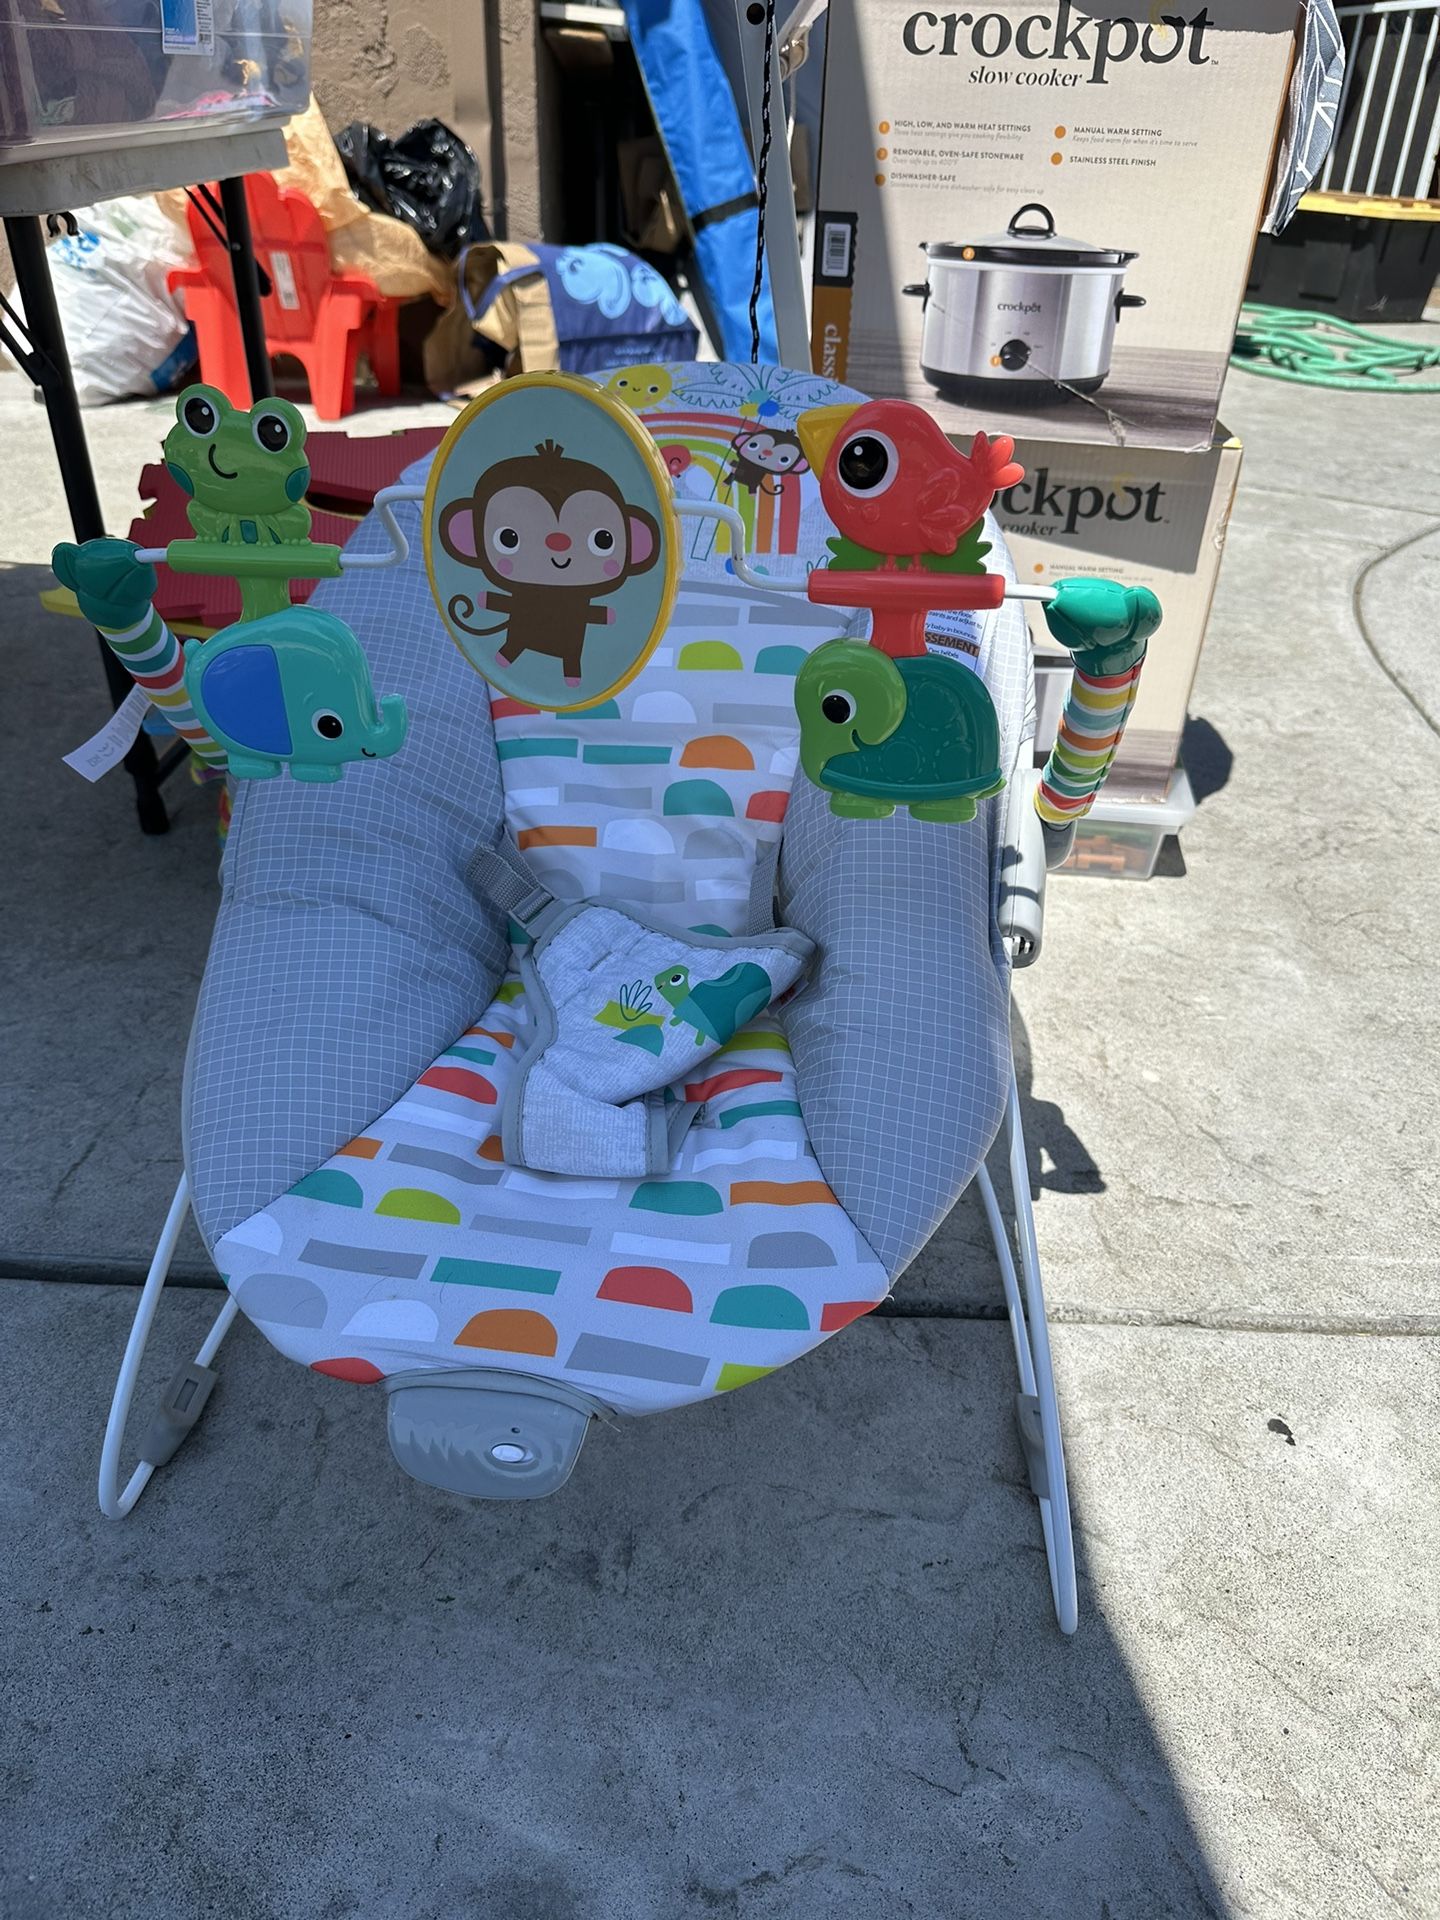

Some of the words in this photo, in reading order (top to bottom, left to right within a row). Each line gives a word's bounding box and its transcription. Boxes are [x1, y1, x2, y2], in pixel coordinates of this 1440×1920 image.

[902, 0, 1214, 84] crockpot
[968, 66, 1013, 85] slow
[1015, 67, 1083, 87] cooker
[894, 119, 916, 129] HIGH,
[917, 120, 935, 130] LOW,
[936, 121, 952, 129] AND
[953, 122, 976, 130] WARM
[977, 122, 996, 131] HEAT
[997, 123, 1032, 133] SETTINGS
[1074, 126, 1105, 134] MANUAL
[1107, 127, 1130, 135] WARM
[1131, 128, 1162, 136] SETTING
[892, 147, 938, 158] REMOVABLE,
[939, 149, 979, 159] OVEN-SAFE
[980, 151, 1025, 161] STONEWARE
[1070, 155, 1107, 164] STAINLESS
[1108, 157, 1130, 165] STEEL
[1131, 158, 1157, 167] FINISH
[997, 301, 1042, 315] crockpot
[822, 323, 842, 383] class
[989, 467, 1167, 535] ckpot
[1001, 521, 1058, 536] cooker
